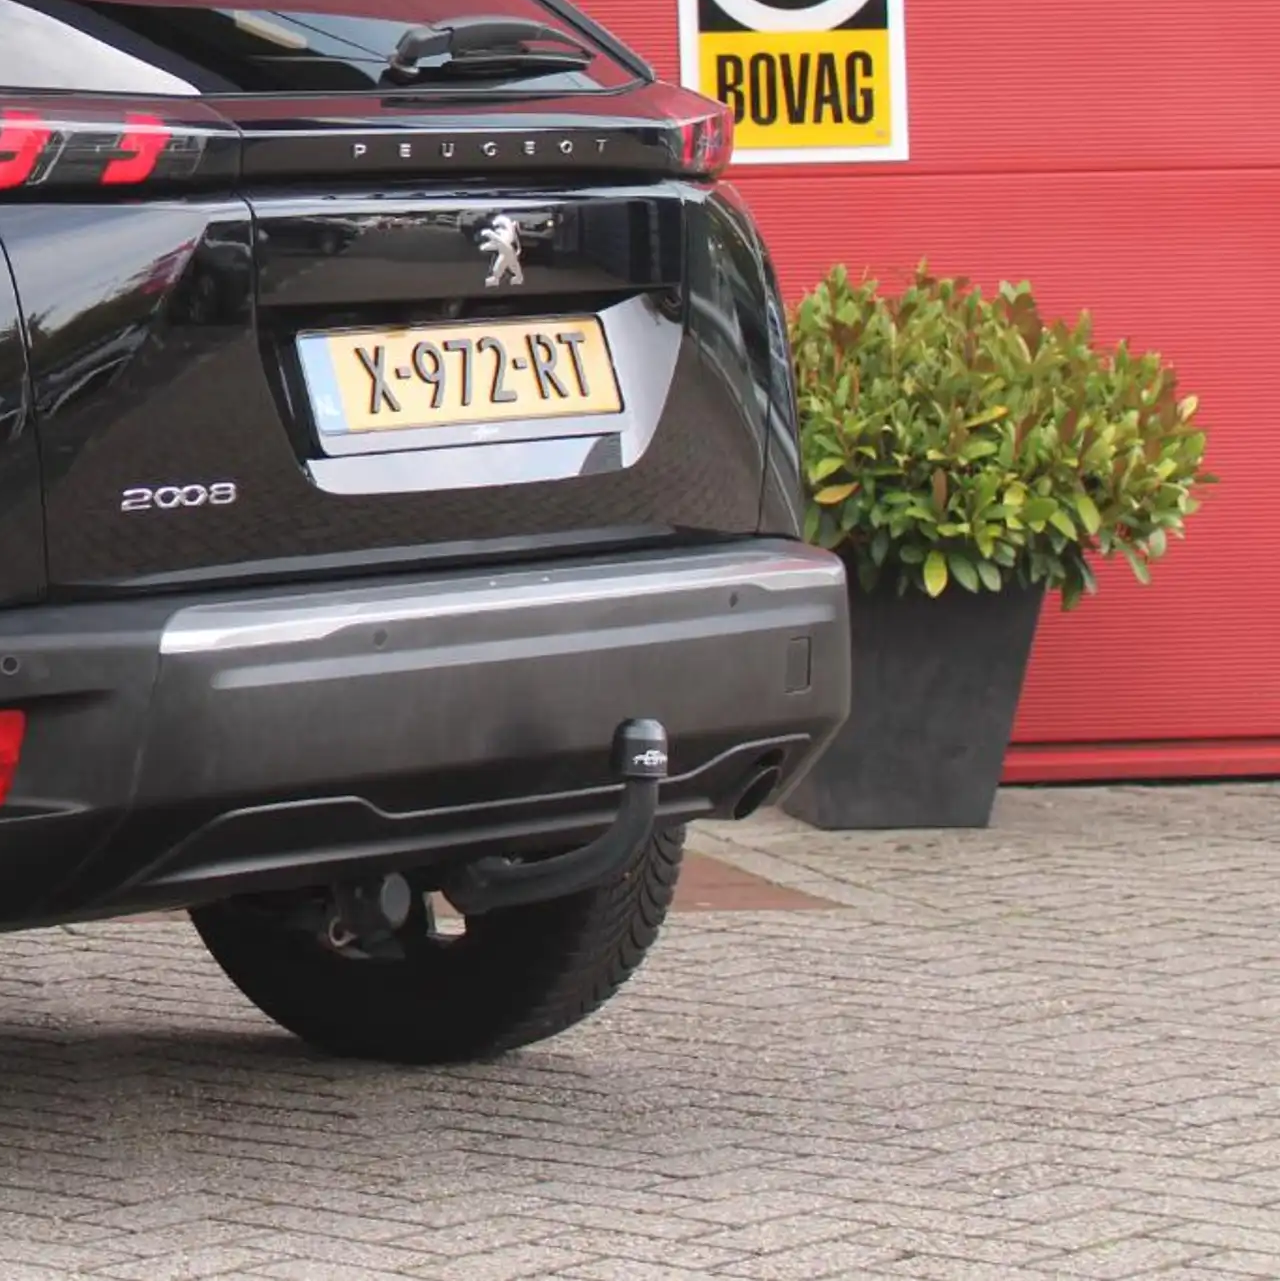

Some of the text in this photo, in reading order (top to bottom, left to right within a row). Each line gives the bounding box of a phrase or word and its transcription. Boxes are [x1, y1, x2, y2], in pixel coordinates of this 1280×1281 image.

[716, 50, 874, 125] BOVAG
[353, 138, 607, 159] PEUGEOT
[354, 331, 590, 414] X-972-RT
[121, 482, 237, 512] 2008
